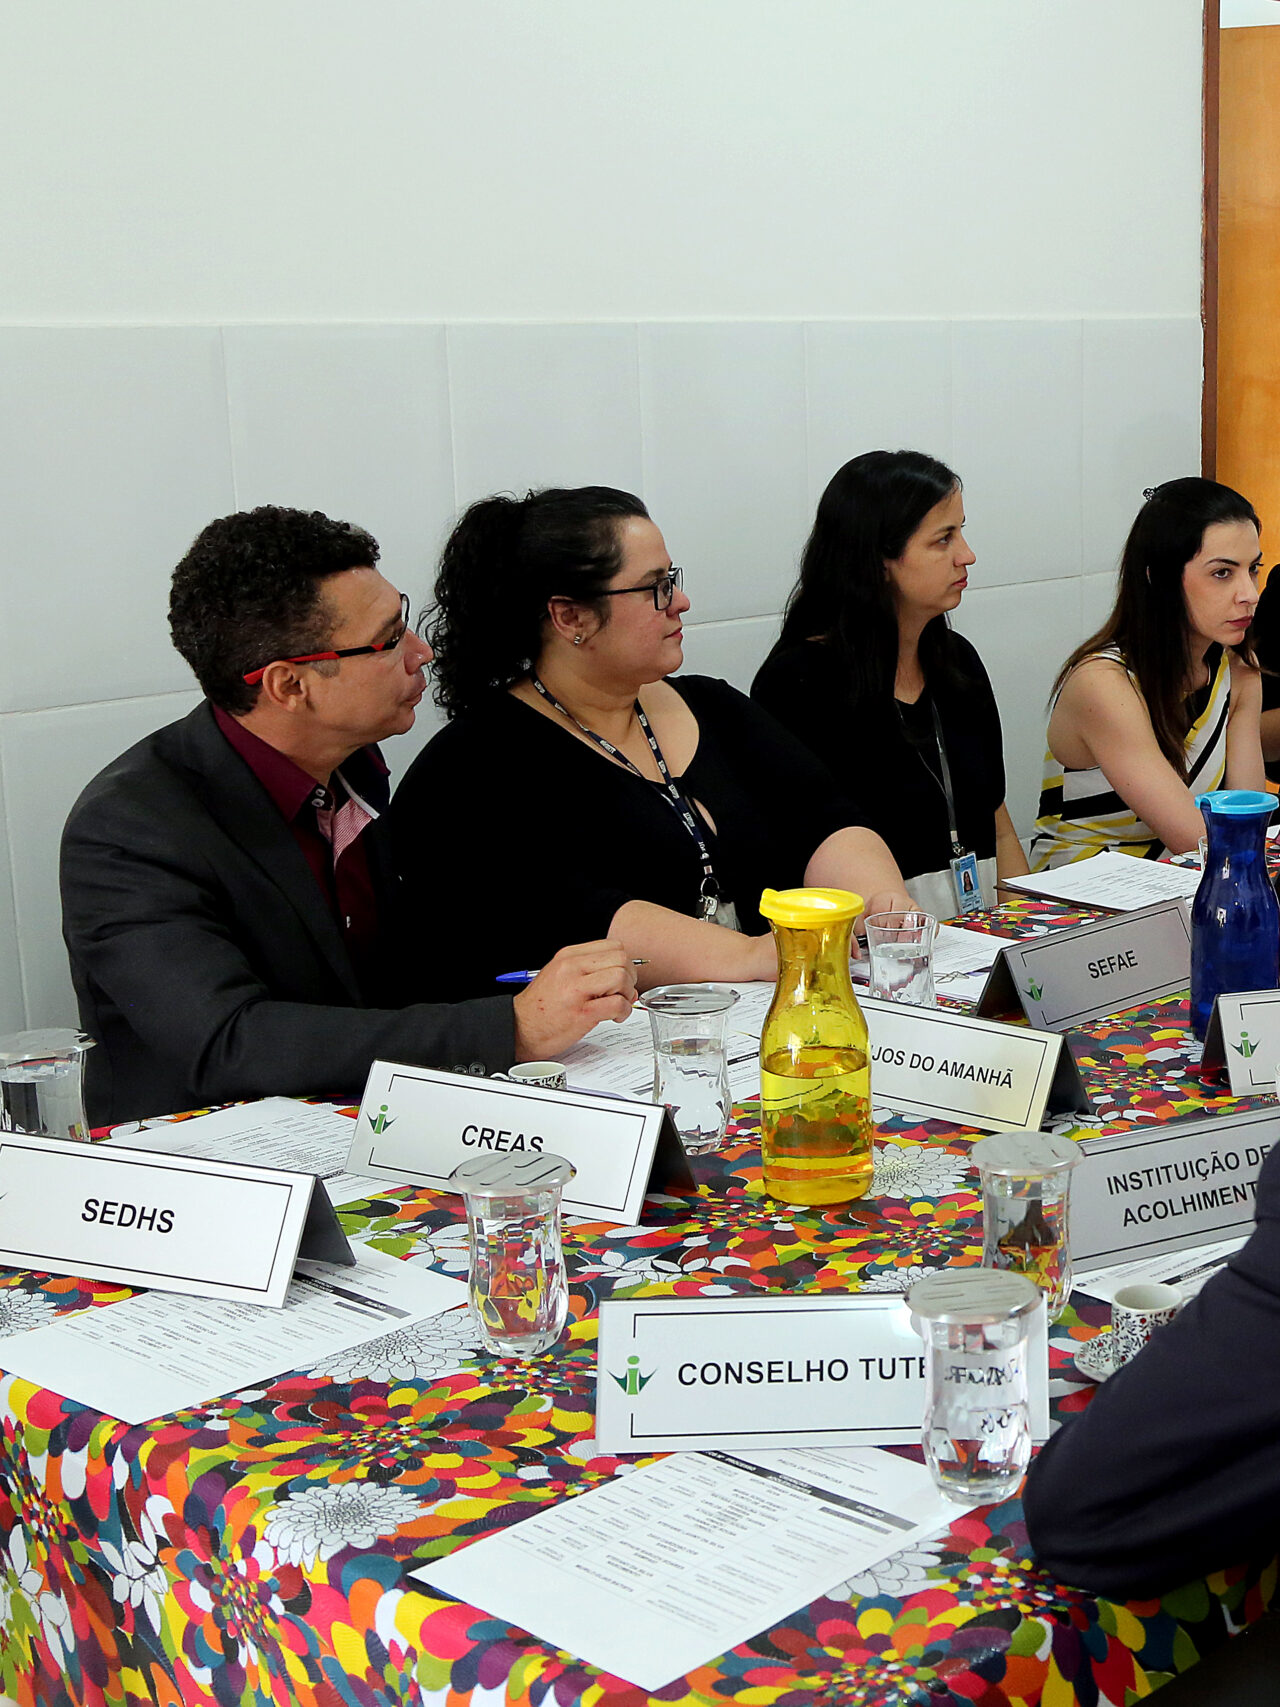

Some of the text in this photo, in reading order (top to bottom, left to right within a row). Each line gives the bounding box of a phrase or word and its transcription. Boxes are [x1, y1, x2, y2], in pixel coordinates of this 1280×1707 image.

[1087, 950, 1138, 979] SEFAE
[909, 1053, 935, 1072] DO
[937, 1060, 1014, 1089] AMANHÃ
[461, 1124, 544, 1153] CREAS
[1106, 1150, 1240, 1196] INSTITUIÇÃO
[81, 1198, 175, 1234] SEDHS
[677, 1358, 849, 1386] CONSELHO
